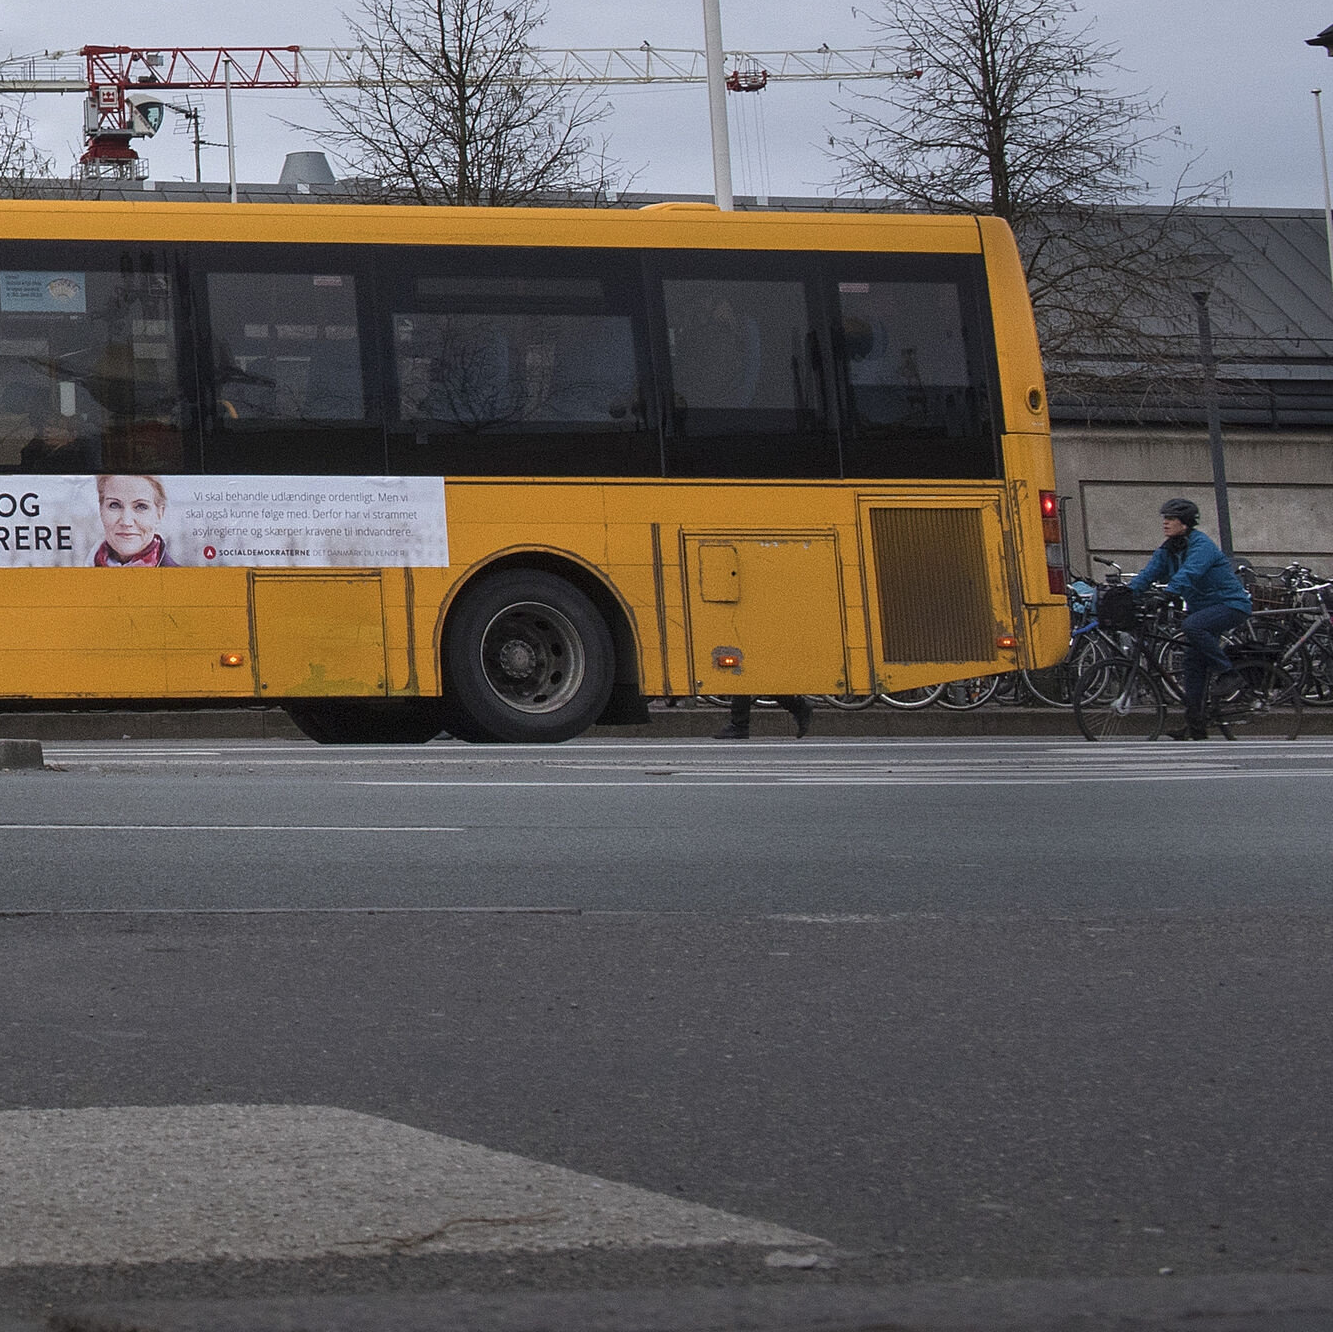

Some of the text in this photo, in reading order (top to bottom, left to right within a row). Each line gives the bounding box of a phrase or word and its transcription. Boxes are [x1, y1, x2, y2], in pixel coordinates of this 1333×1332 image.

[193, 491, 203, 501] Vi
[205, 491, 224, 502] skal
[225, 491, 270, 502] behandle
[271, 491, 326, 505] udlændinge
[378, 492, 399, 502] Men
[400, 492, 409, 502] vi
[185, 508, 418, 521] skal også kunne følge med. Derfor har vi strammet
[192, 526, 414, 538] asylreglerne og skærper kravene til indvandrere.
[219, 549, 311, 557] SOCIALDEMOKRATERNE
[313, 549, 326, 557] DET
[327, 549, 363, 557] DANMARK
